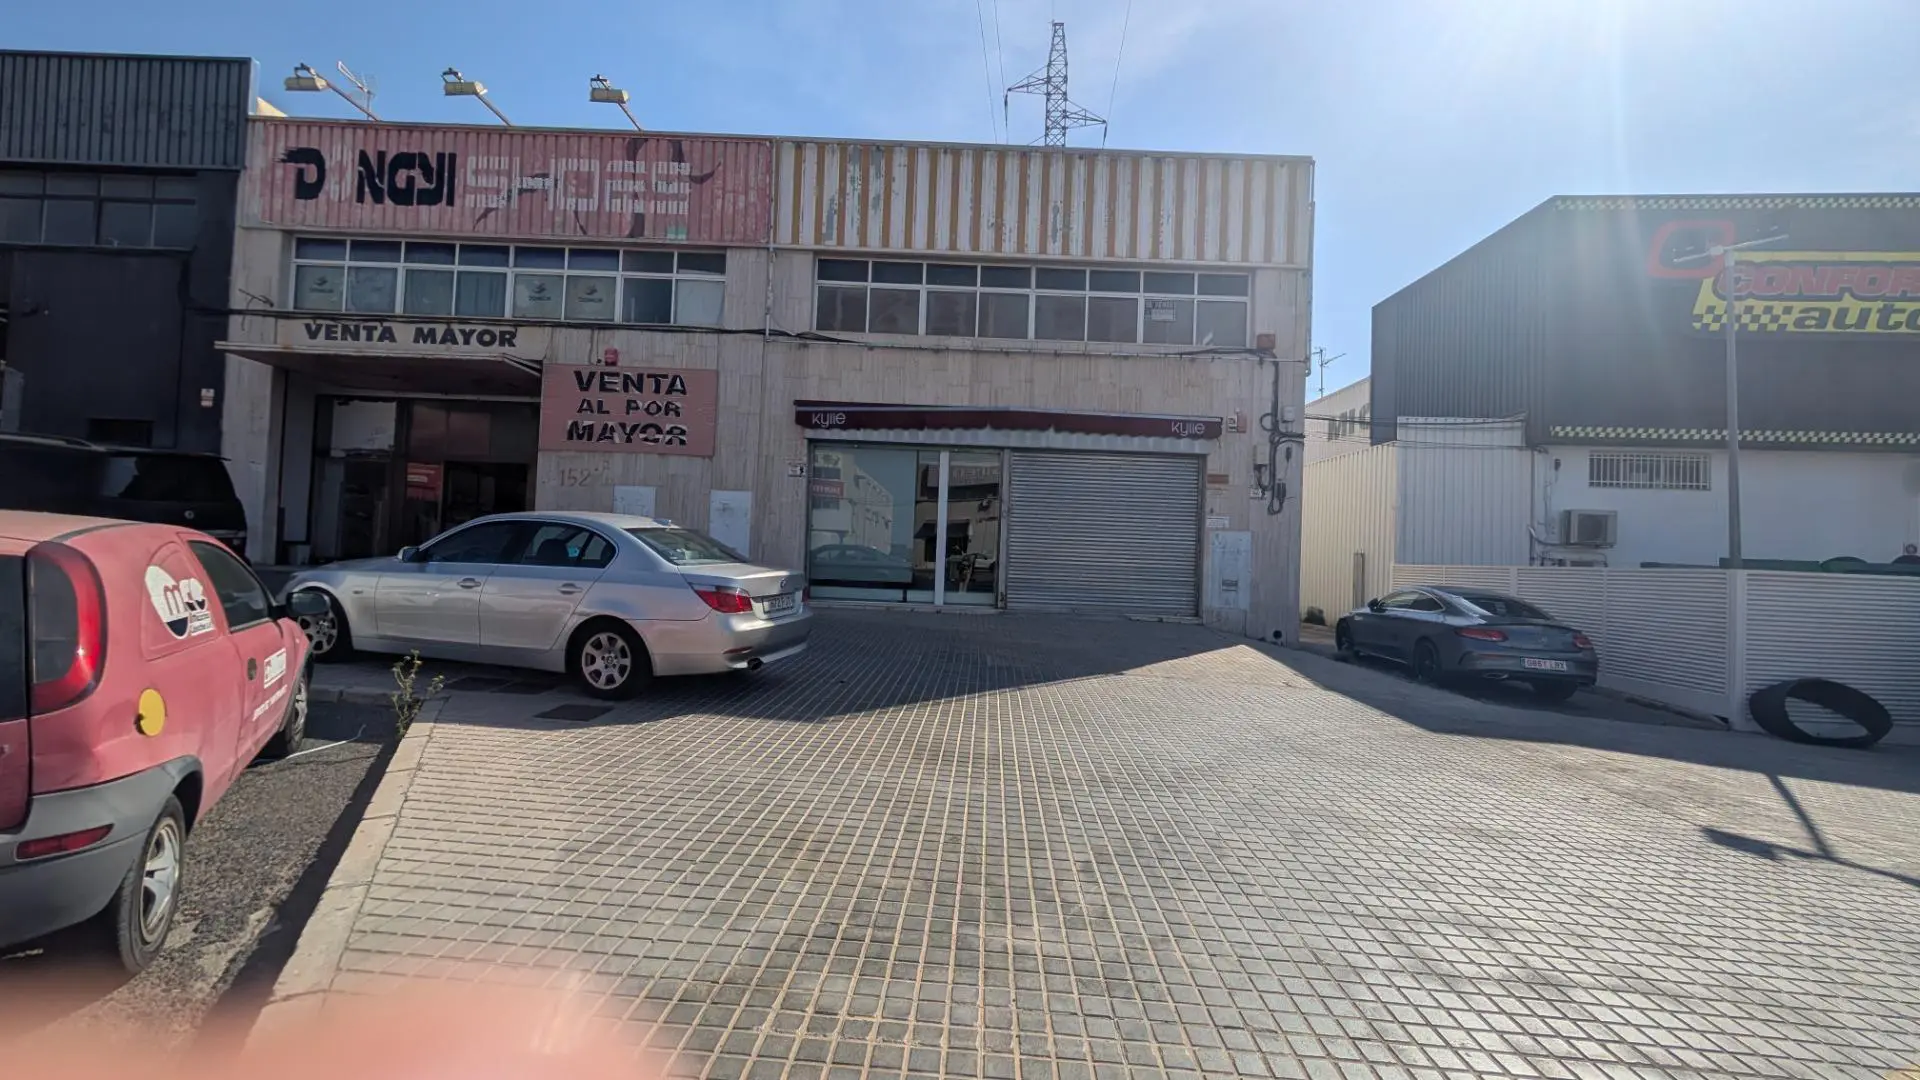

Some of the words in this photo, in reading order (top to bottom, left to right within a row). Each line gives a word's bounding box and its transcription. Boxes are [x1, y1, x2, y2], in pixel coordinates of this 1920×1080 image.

[465, 155, 691, 215] SHOES
[304, 322, 398, 343] VENTA
[412, 326, 517, 348] MAYOR
[573, 370, 687, 396] VENTA
[576, 398, 611, 415] AL
[625, 399, 682, 418] POR
[566, 420, 688, 446] MAYOR
